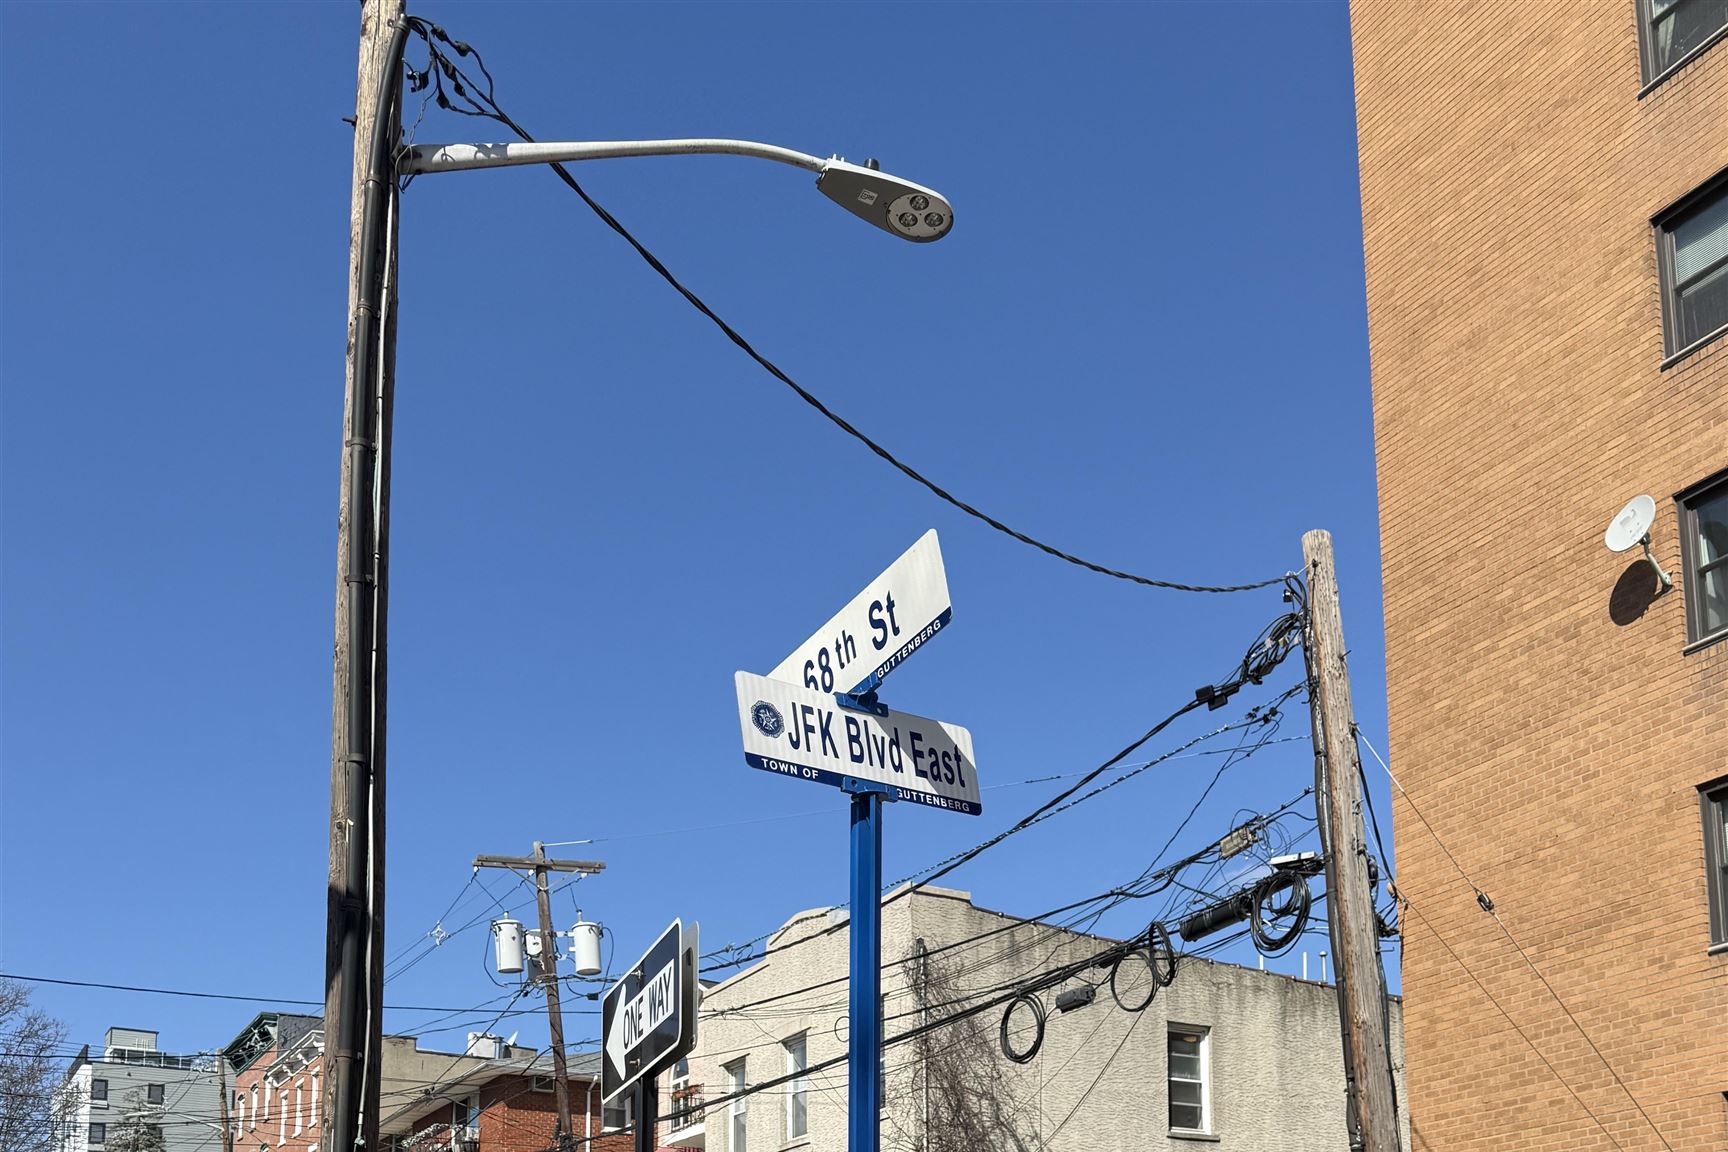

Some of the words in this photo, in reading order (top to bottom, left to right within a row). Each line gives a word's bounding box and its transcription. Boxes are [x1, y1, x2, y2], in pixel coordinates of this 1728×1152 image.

[803, 630, 857, 694] 68th
[868, 590, 900, 651] St
[877, 619, 941, 679] GUTTENBERG
[761, 758, 799, 776] TOWN
[802, 766, 819, 780] OF
[788, 702, 840, 759] JFK
[845, 715, 904, 774] Blvd
[909, 730, 966, 788] East
[896, 788, 971, 812] GUTTENBERG
[623, 995, 644, 1050] ONE
[648, 966, 673, 1028] WAY
